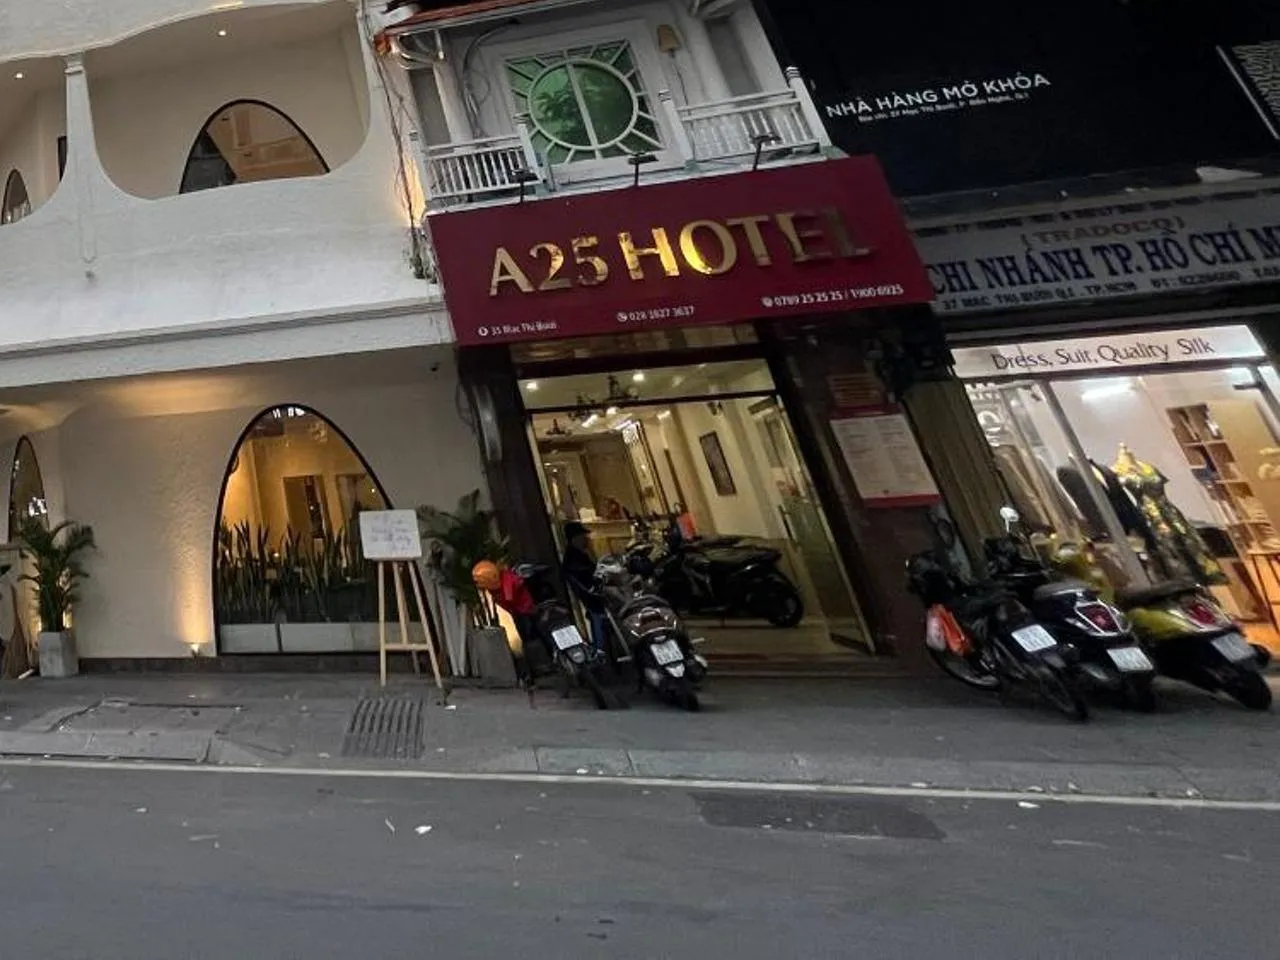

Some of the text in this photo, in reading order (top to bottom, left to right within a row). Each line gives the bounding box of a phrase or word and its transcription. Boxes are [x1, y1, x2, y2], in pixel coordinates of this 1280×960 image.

[876, 90, 938, 110] HÀNG
[488, 208, 874, 297] A25 HOTEL
[925, 260, 979, 295] CHI
[975, 243, 1096, 290] NHÁNH
[1097, 340, 1170, 363] Quality
[1176, 337, 1216, 356] Silk
